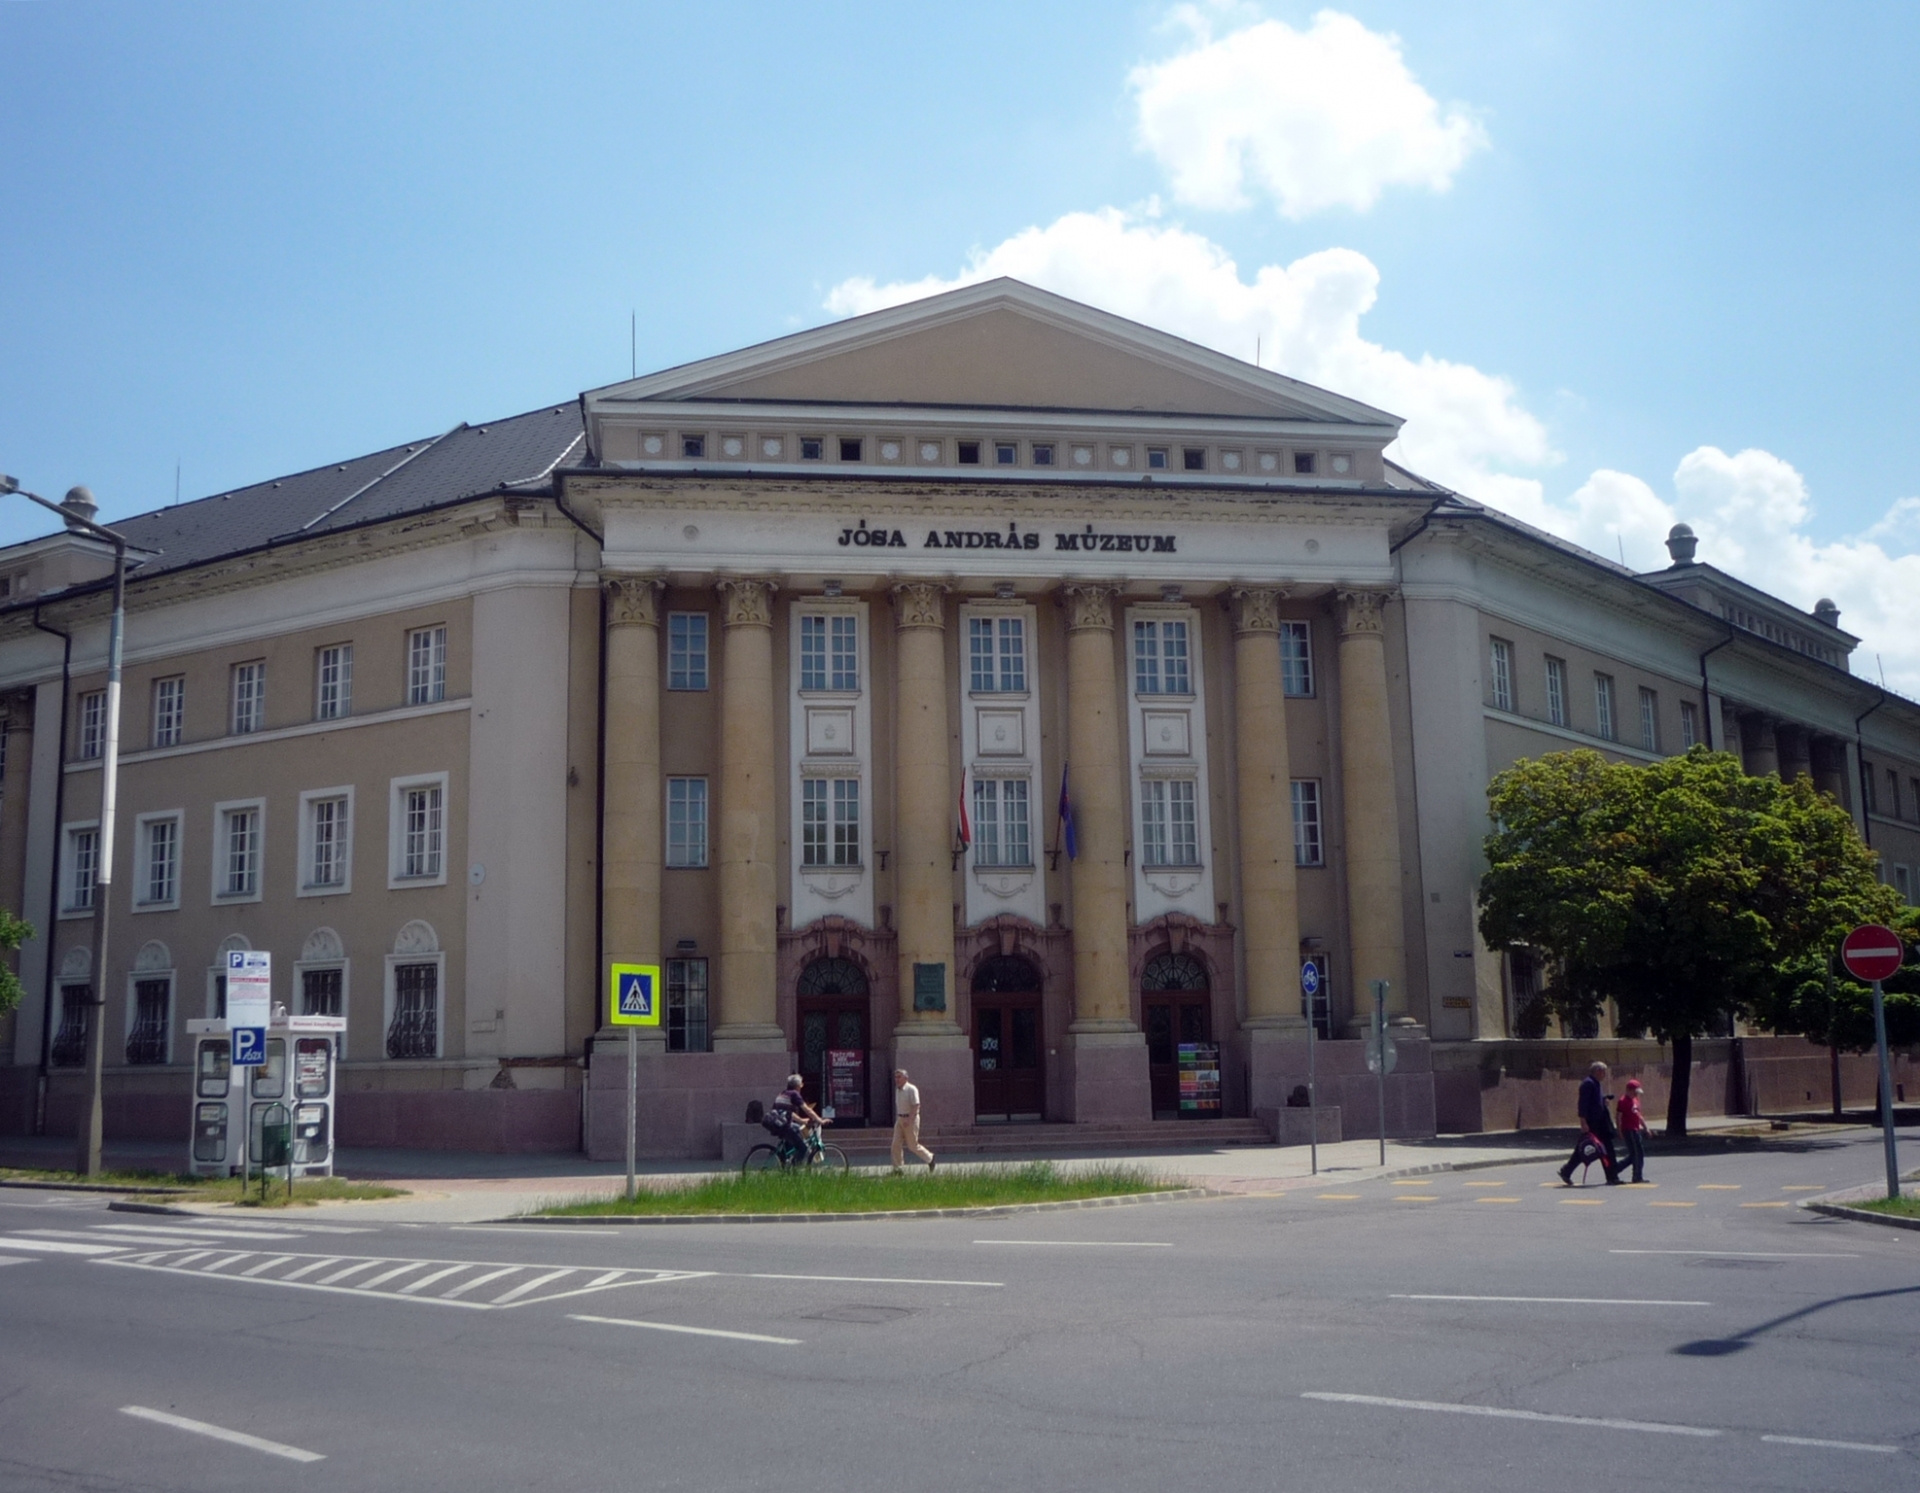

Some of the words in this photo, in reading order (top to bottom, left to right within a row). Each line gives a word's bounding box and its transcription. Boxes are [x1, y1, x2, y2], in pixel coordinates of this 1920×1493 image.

[838, 519, 906, 547] JÓSA
[924, 522, 1040, 550] ANDRÁS
[1055, 524, 1177, 552] MÚZEUM
[232, 954, 242, 967] P
[236, 1030, 256, 1060] P
